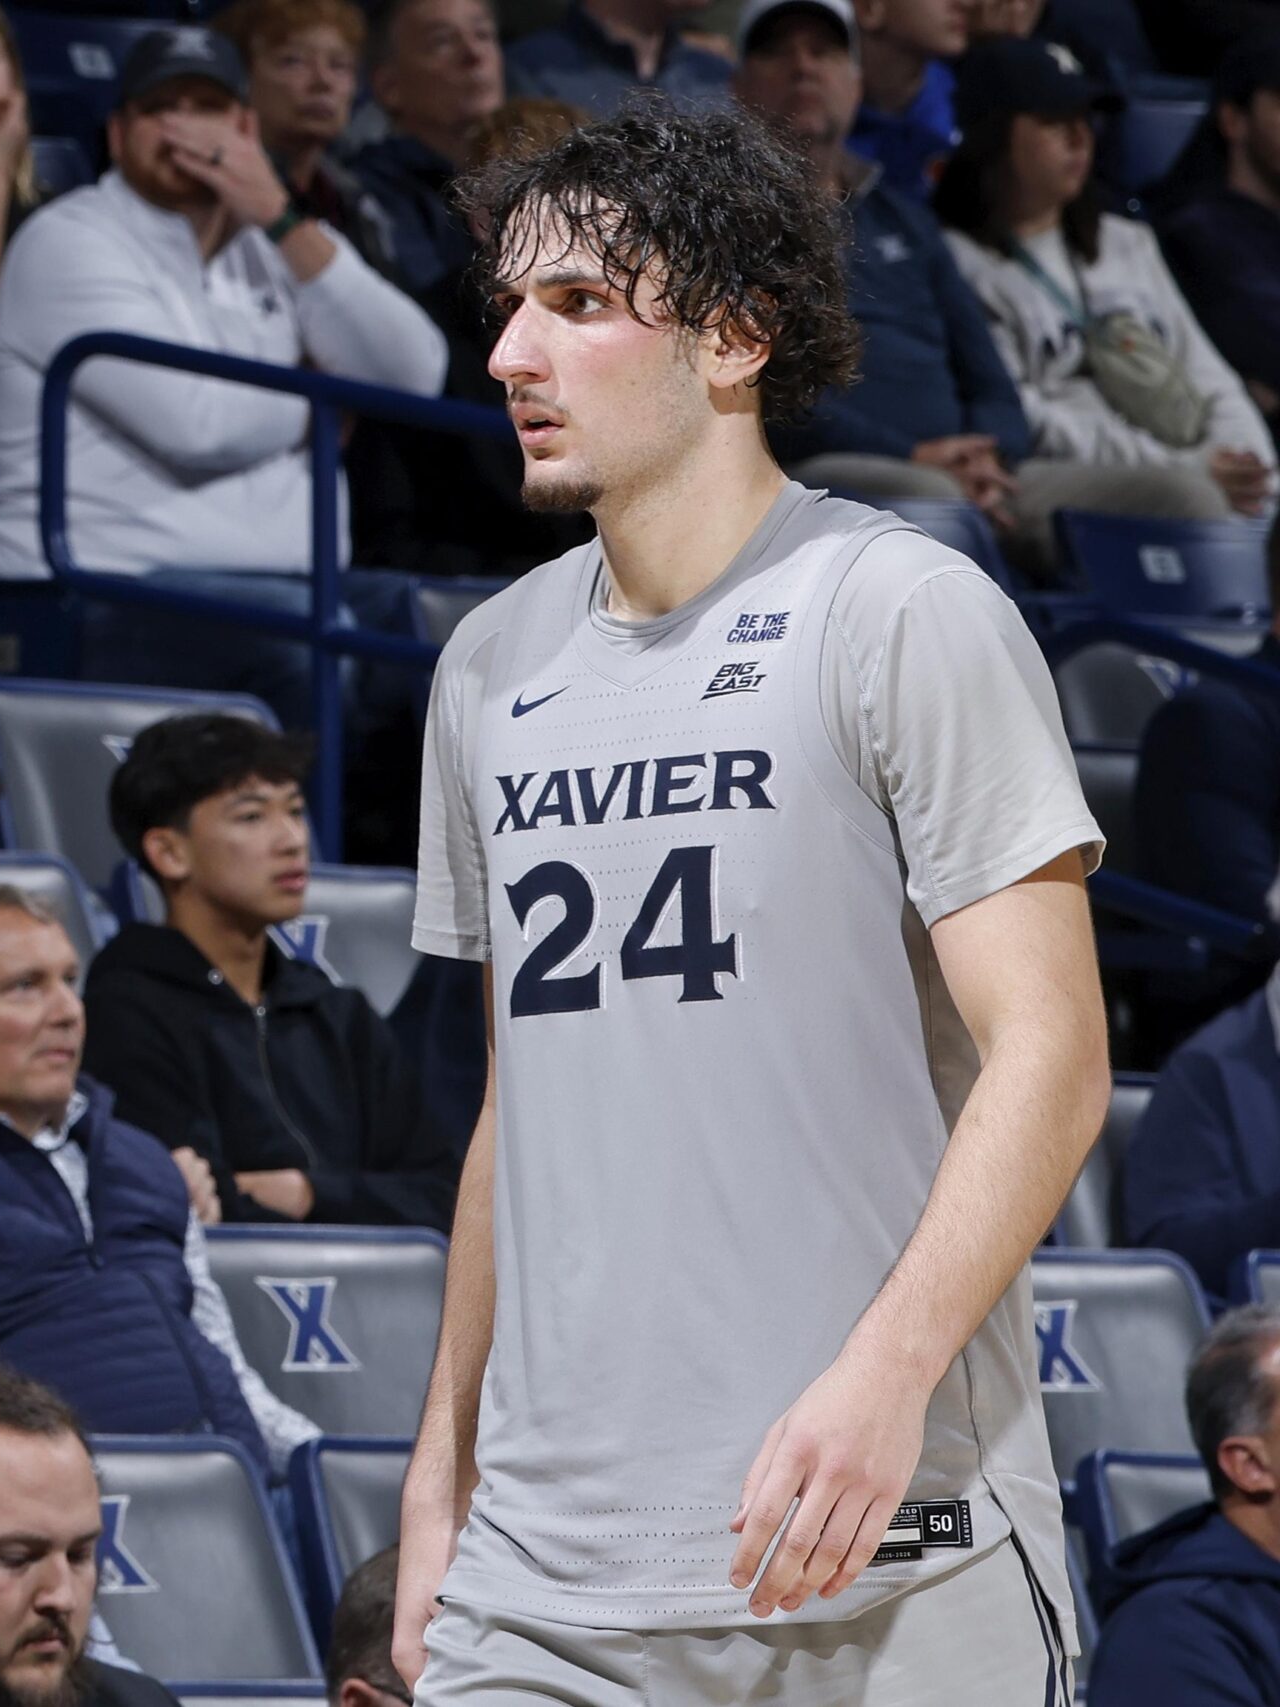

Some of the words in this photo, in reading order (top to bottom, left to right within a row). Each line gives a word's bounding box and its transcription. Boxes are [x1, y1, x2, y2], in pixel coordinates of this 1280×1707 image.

[736, 613, 760, 629] BE
[762, 611, 791, 628] THE
[726, 626, 788, 643] CHANGE
[714, 661, 761, 678] BIG
[705, 674, 768, 692] EAST
[492, 749, 781, 836] XAVIER
[504, 845, 744, 1019] 24
[253, 1276, 363, 1372] X
[929, 1514, 953, 1532] 50
